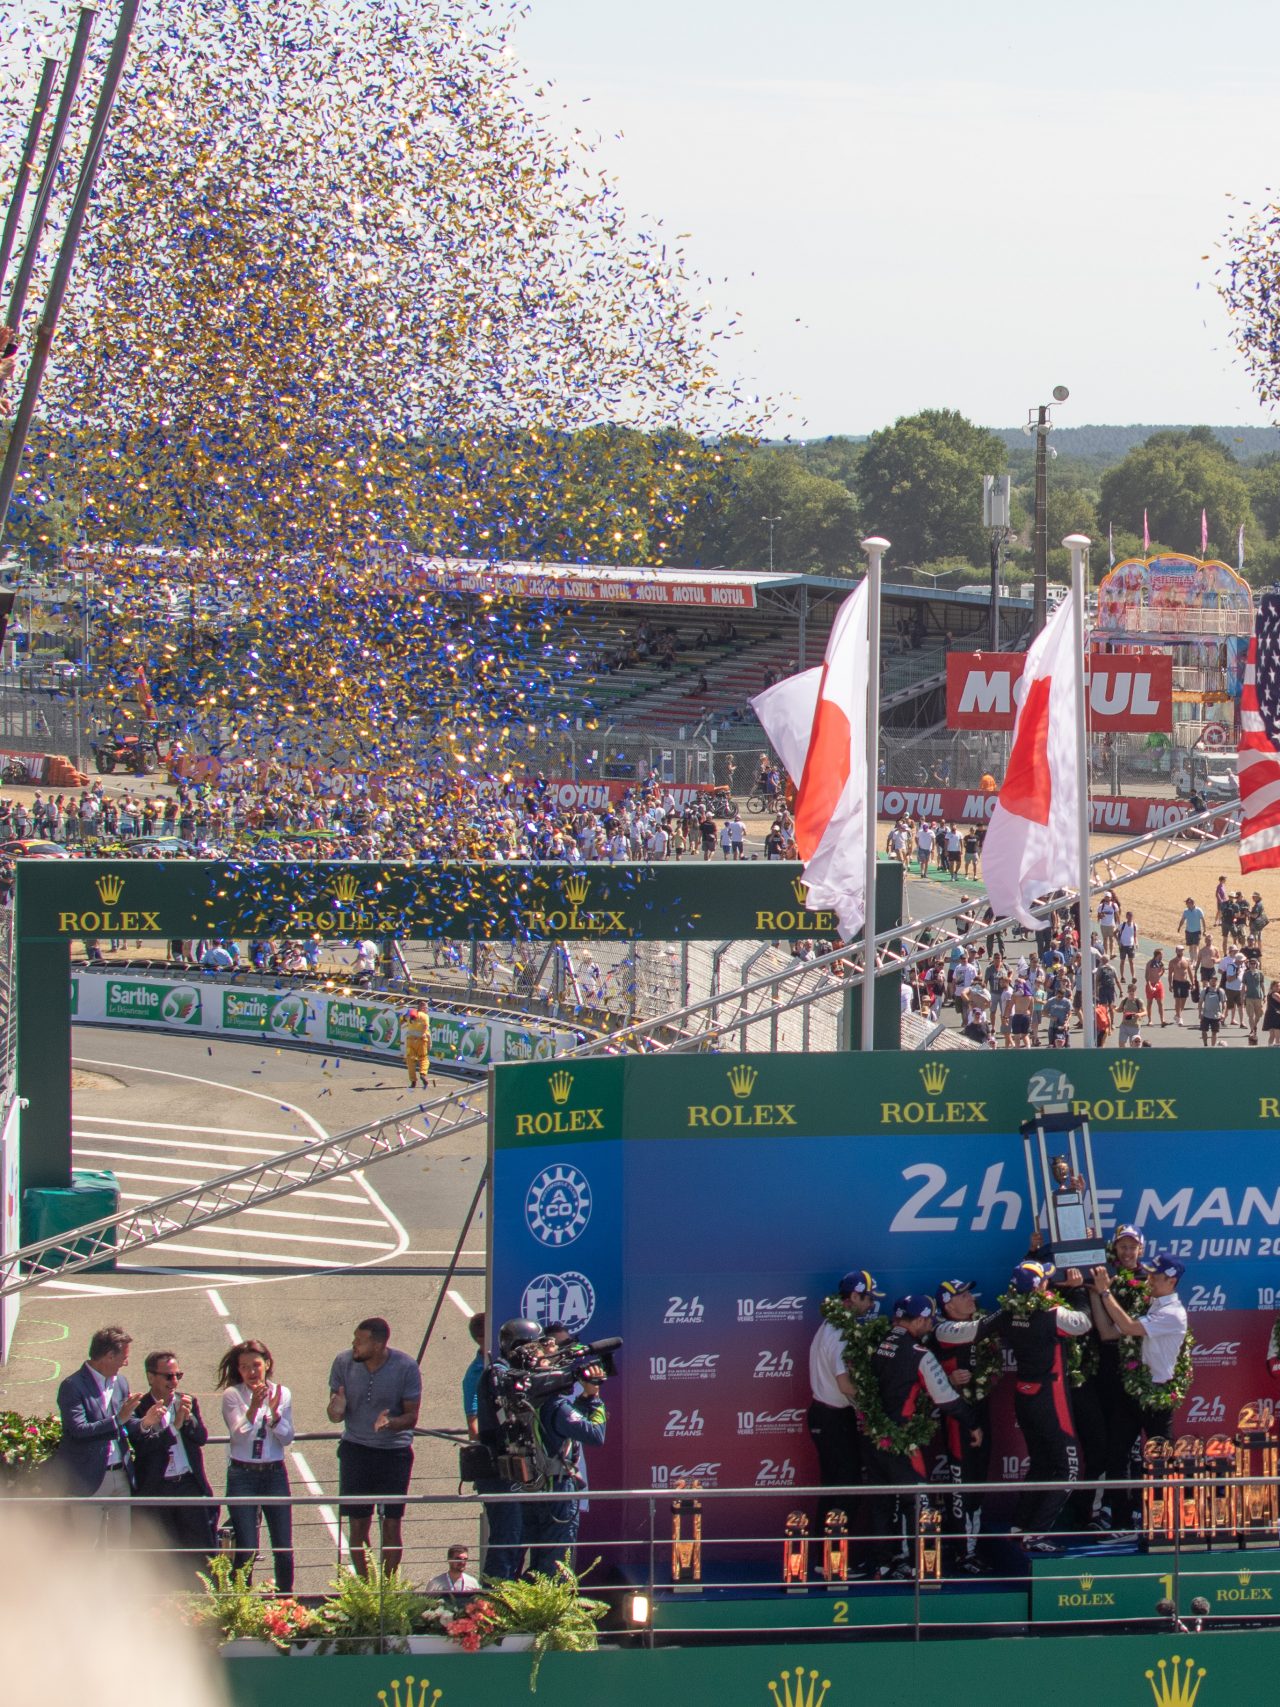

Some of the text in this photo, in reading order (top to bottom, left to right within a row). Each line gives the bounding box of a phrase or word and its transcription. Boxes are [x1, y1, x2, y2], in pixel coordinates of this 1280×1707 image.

[637, 585, 668, 601] MOTUL
[672, 586, 706, 602] MOTUL
[711, 589, 745, 604] MOTUL
[958, 671, 1160, 714] MUL
[1088, 801, 1130, 826] TUL
[59, 911, 161, 931] ROLEX
[296, 911, 395, 931] ROLEX
[527, 911, 626, 931] ROLEX
[756, 911, 838, 931] ROLE
[110, 984, 158, 1007] Sarthe
[431, 1024, 458, 1044] arthe
[688, 1104, 798, 1127] ROLEX
[881, 1102, 988, 1123] ROLEX
[1071, 1098, 1177, 1121] ROLEX
[515, 1108, 604, 1136] ROLEX
[889, 1162, 1022, 1232] 24h
[545, 1203, 572, 1217] CO
[1198, 1238, 1251, 1260] JUIN
[1188, 1285, 1227, 1305] 24h
[1258, 1288, 1273, 1305] 10
[665, 1296, 704, 1317] 24h
[737, 1299, 754, 1316] 10
[650, 1357, 666, 1374] 10
[755, 1351, 793, 1371] 24h
[1188, 1396, 1226, 1417] 24h
[665, 1409, 704, 1430] 24h
[737, 1412, 754, 1429] 10
[652, 1466, 668, 1482] 10
[757, 1458, 795, 1480] 24h
[1003, 1456, 1018, 1473] 10
[1066, 1446, 1077, 1487] DENS
[825, 1511, 848, 1525] 24h
[1159, 1574, 1174, 1601] 1
[1216, 1588, 1273, 1601] ROLEX
[1058, 1593, 1115, 1607] ROLEX
[833, 1601, 849, 1623] 2
